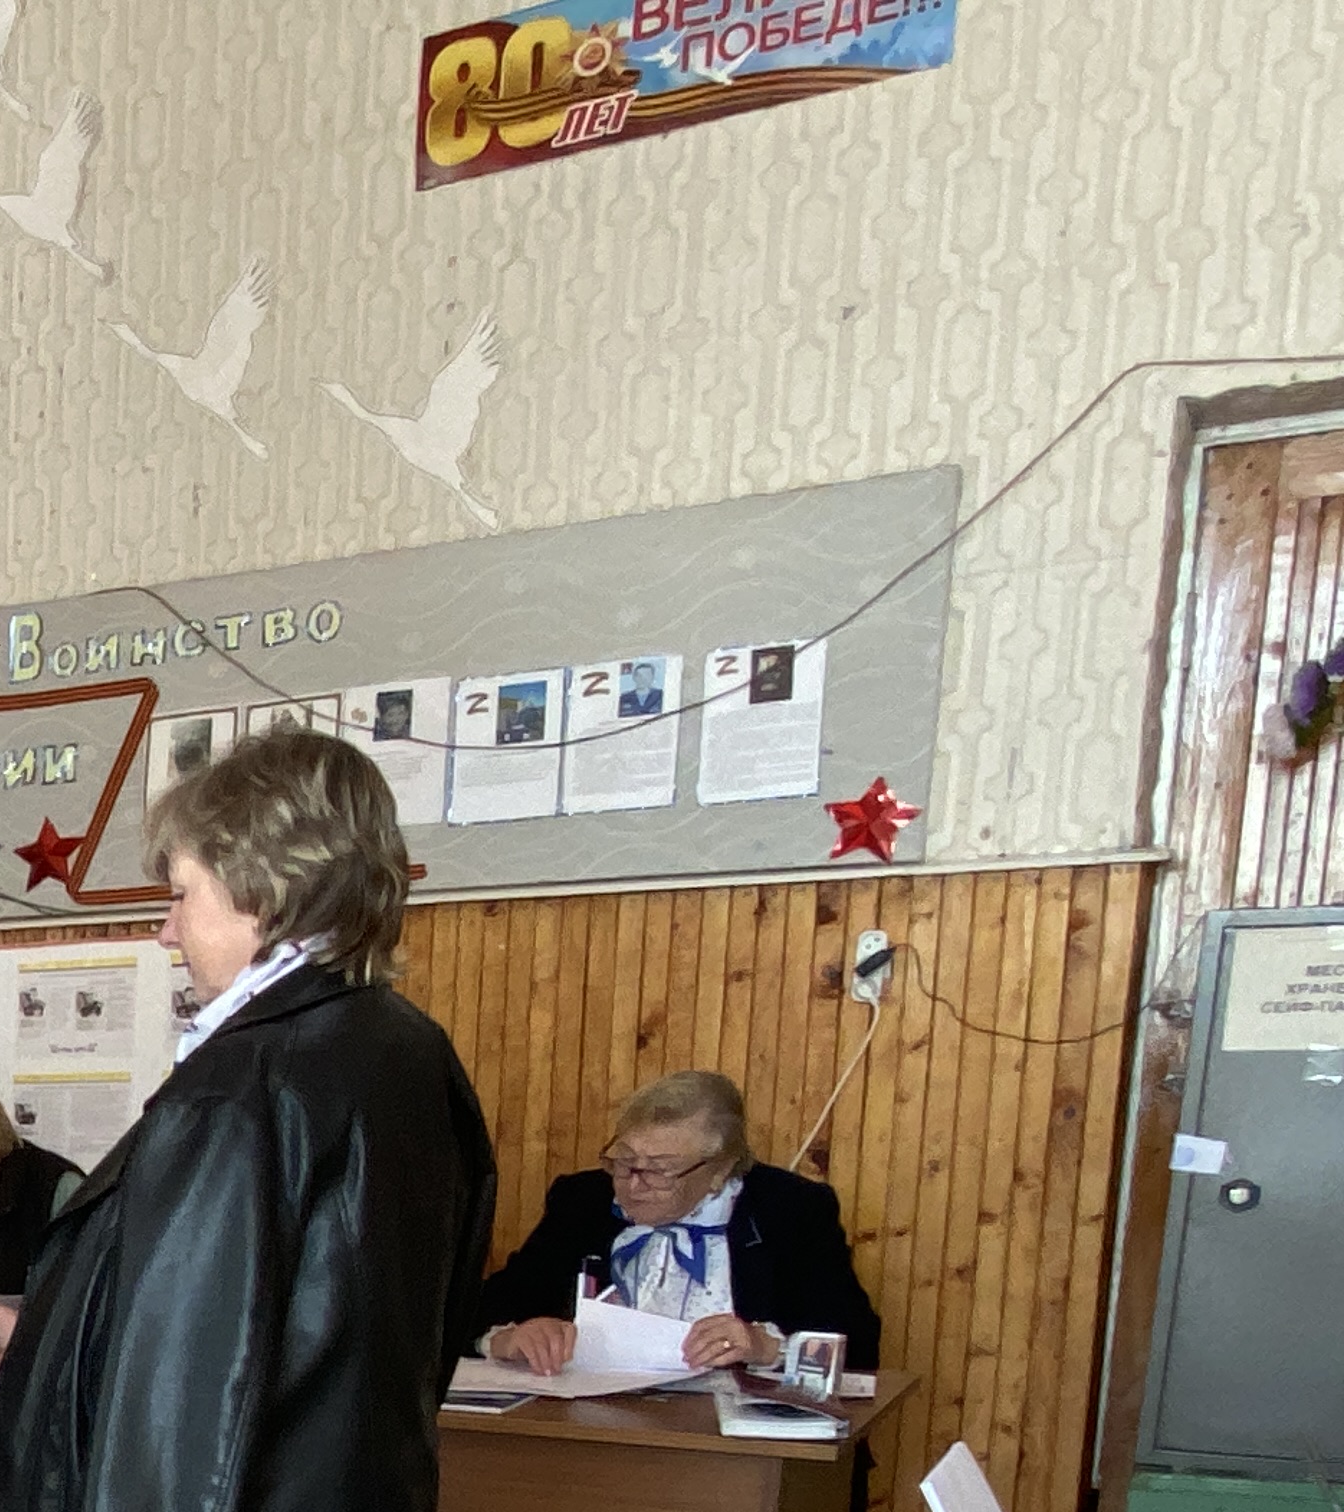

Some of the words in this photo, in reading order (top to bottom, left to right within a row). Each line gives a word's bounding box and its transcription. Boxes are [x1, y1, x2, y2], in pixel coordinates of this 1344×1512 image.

[425, 17, 572, 167] 80
[551, 90, 639, 148] ЛЕТ
[8, 600, 344, 685] Воинство
